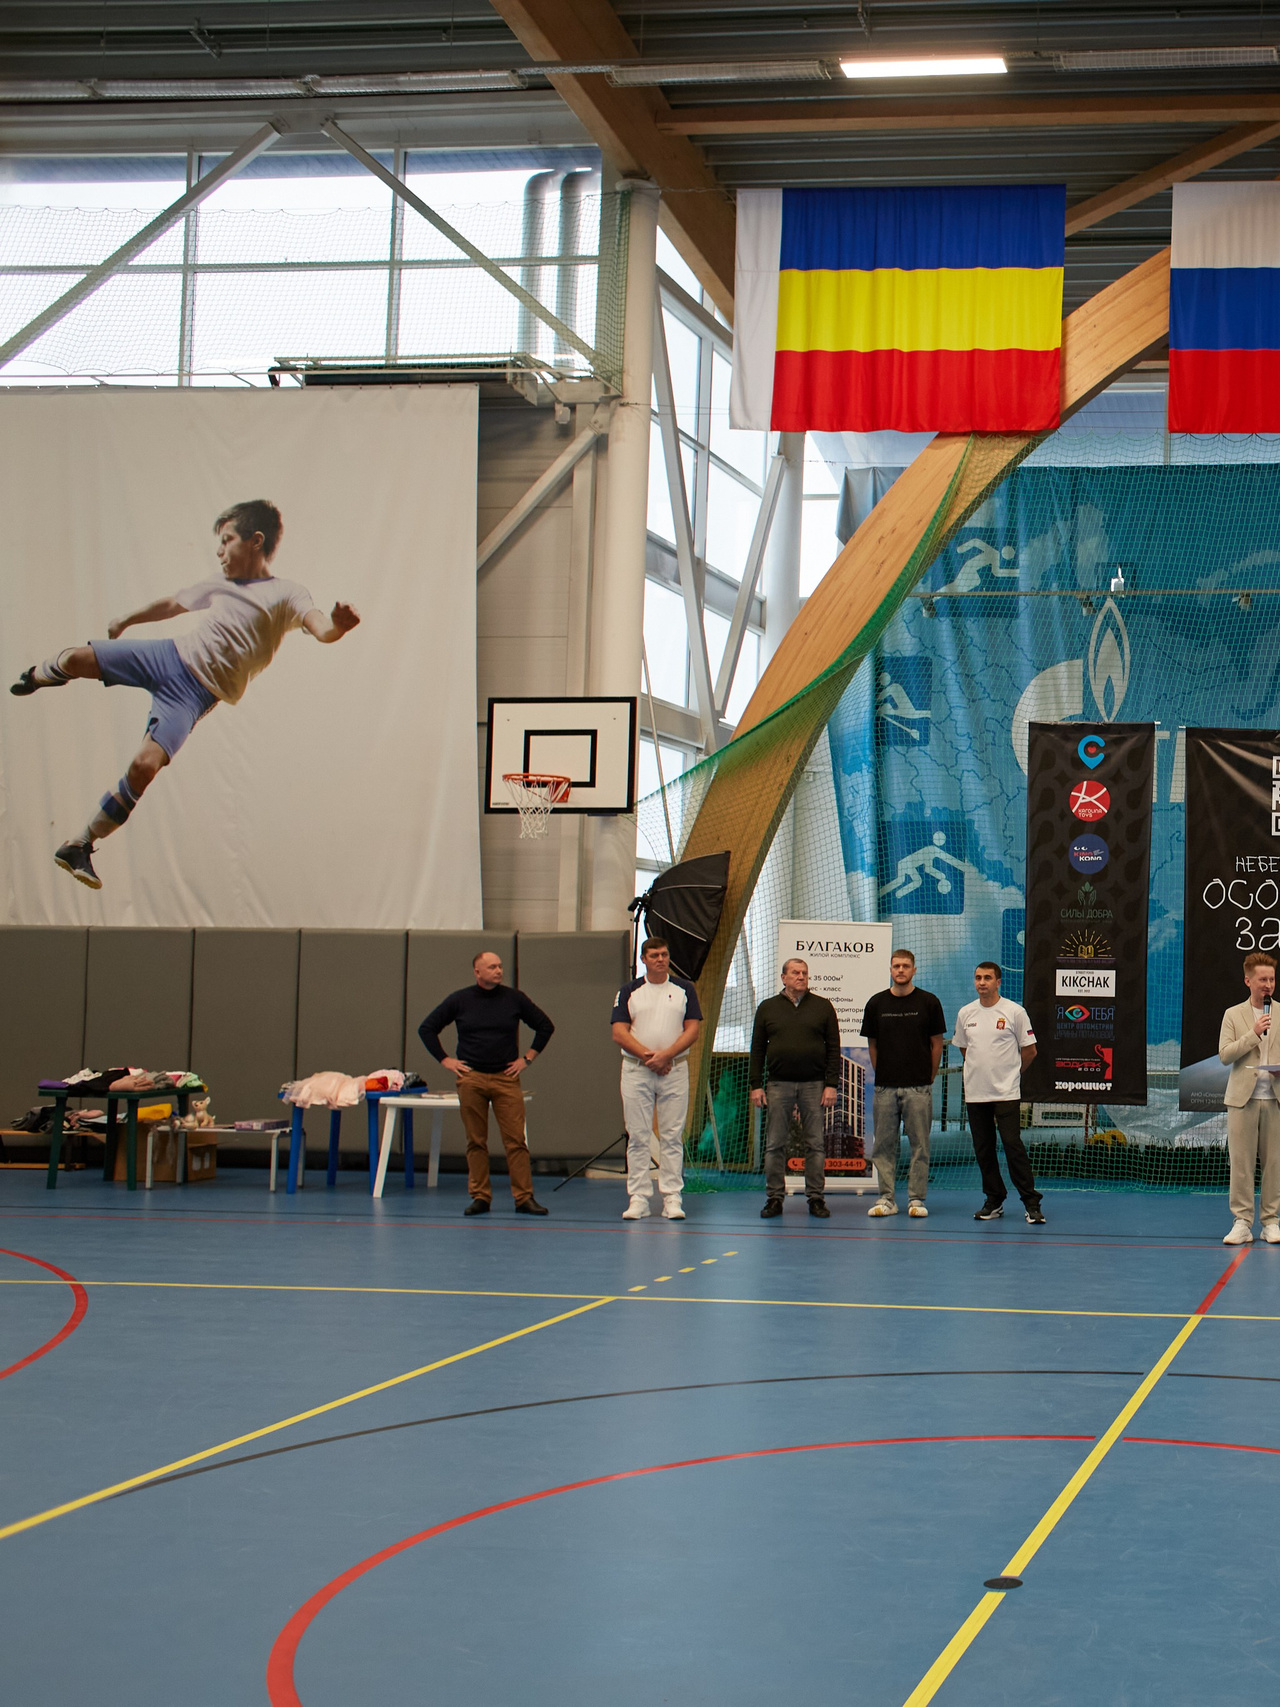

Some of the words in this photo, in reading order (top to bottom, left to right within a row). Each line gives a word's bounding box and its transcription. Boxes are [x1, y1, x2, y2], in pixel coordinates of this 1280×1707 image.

[1060, 908, 1084, 918] СИЛЫ
[1087, 909, 1113, 919] ДОБРА
[796, 940, 874, 953] БУЛГАКОВ
[1061, 975, 1110, 988] KIKCHAK
[1056, 1006, 1064, 1019] Я
[1090, 1007, 1114, 1020] ТЕБЯ
